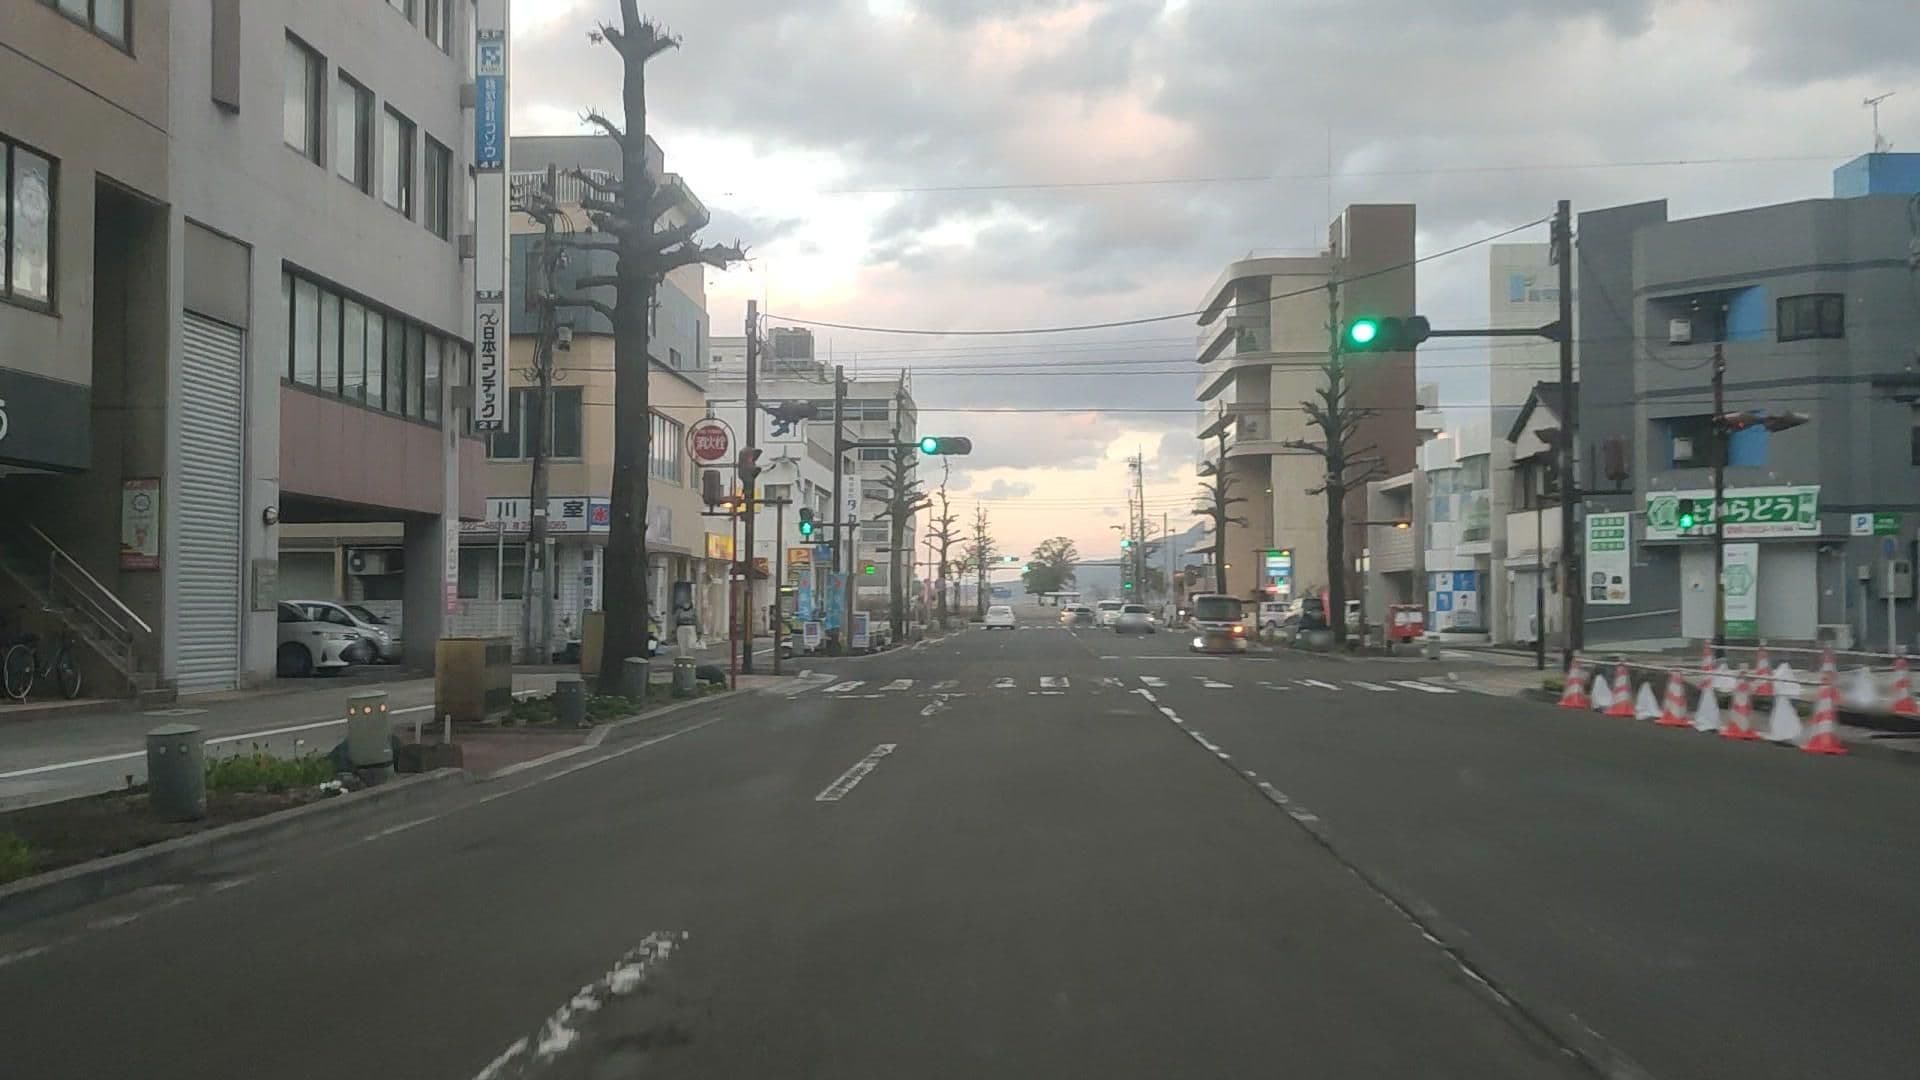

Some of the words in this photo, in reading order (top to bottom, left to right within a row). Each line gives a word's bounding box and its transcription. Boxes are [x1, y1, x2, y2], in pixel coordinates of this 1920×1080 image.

[481, 326, 497, 419] 日本コンテック
[480, 421, 500, 430] 2F
